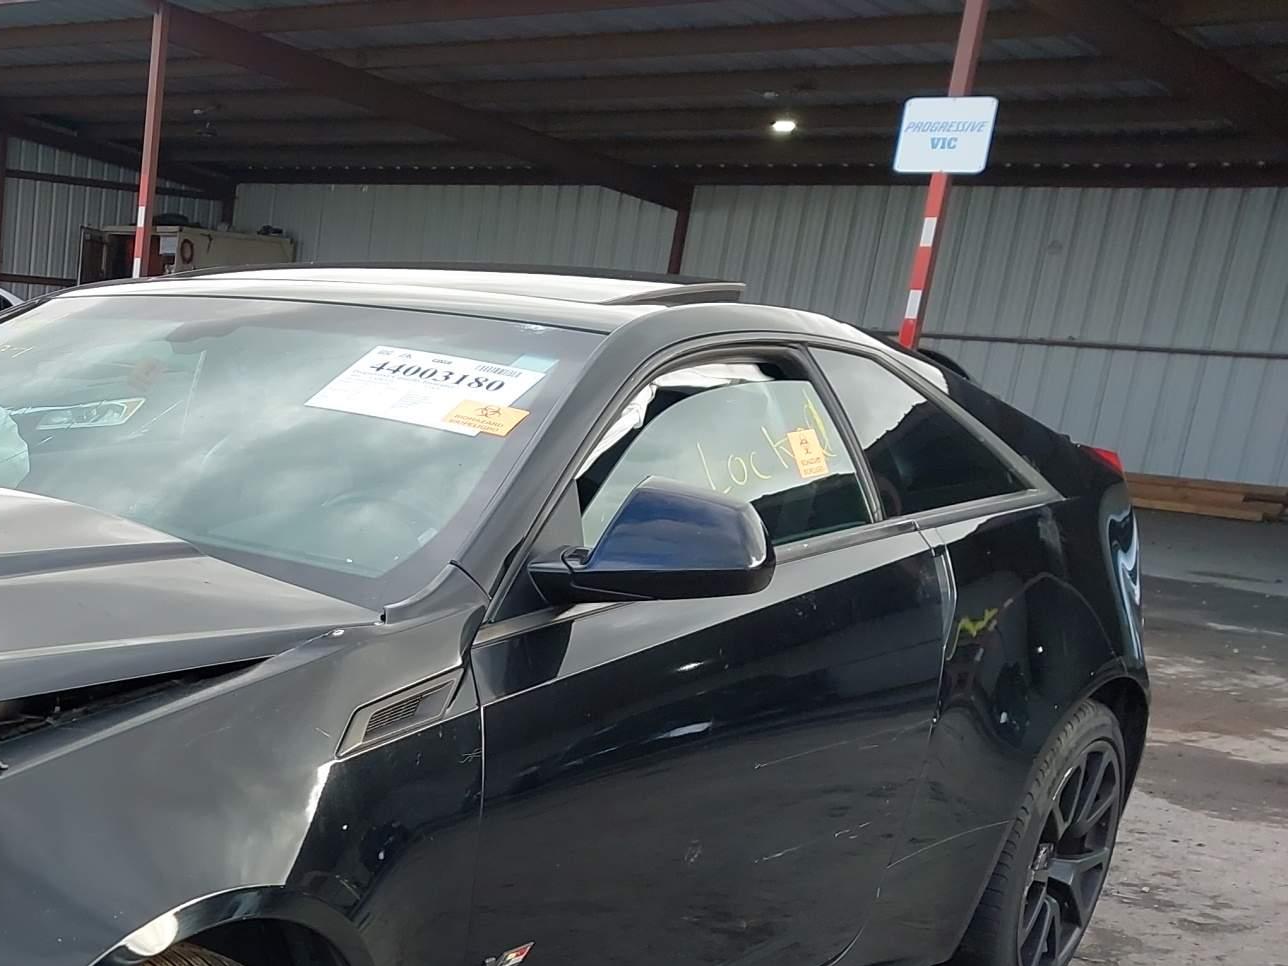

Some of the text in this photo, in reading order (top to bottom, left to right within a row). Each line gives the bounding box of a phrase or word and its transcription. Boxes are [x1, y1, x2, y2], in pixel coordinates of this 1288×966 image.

[903, 120, 989, 133] PROGRESSIVE
[930, 137, 958, 150] VIC
[369, 360, 506, 392] 44003180
